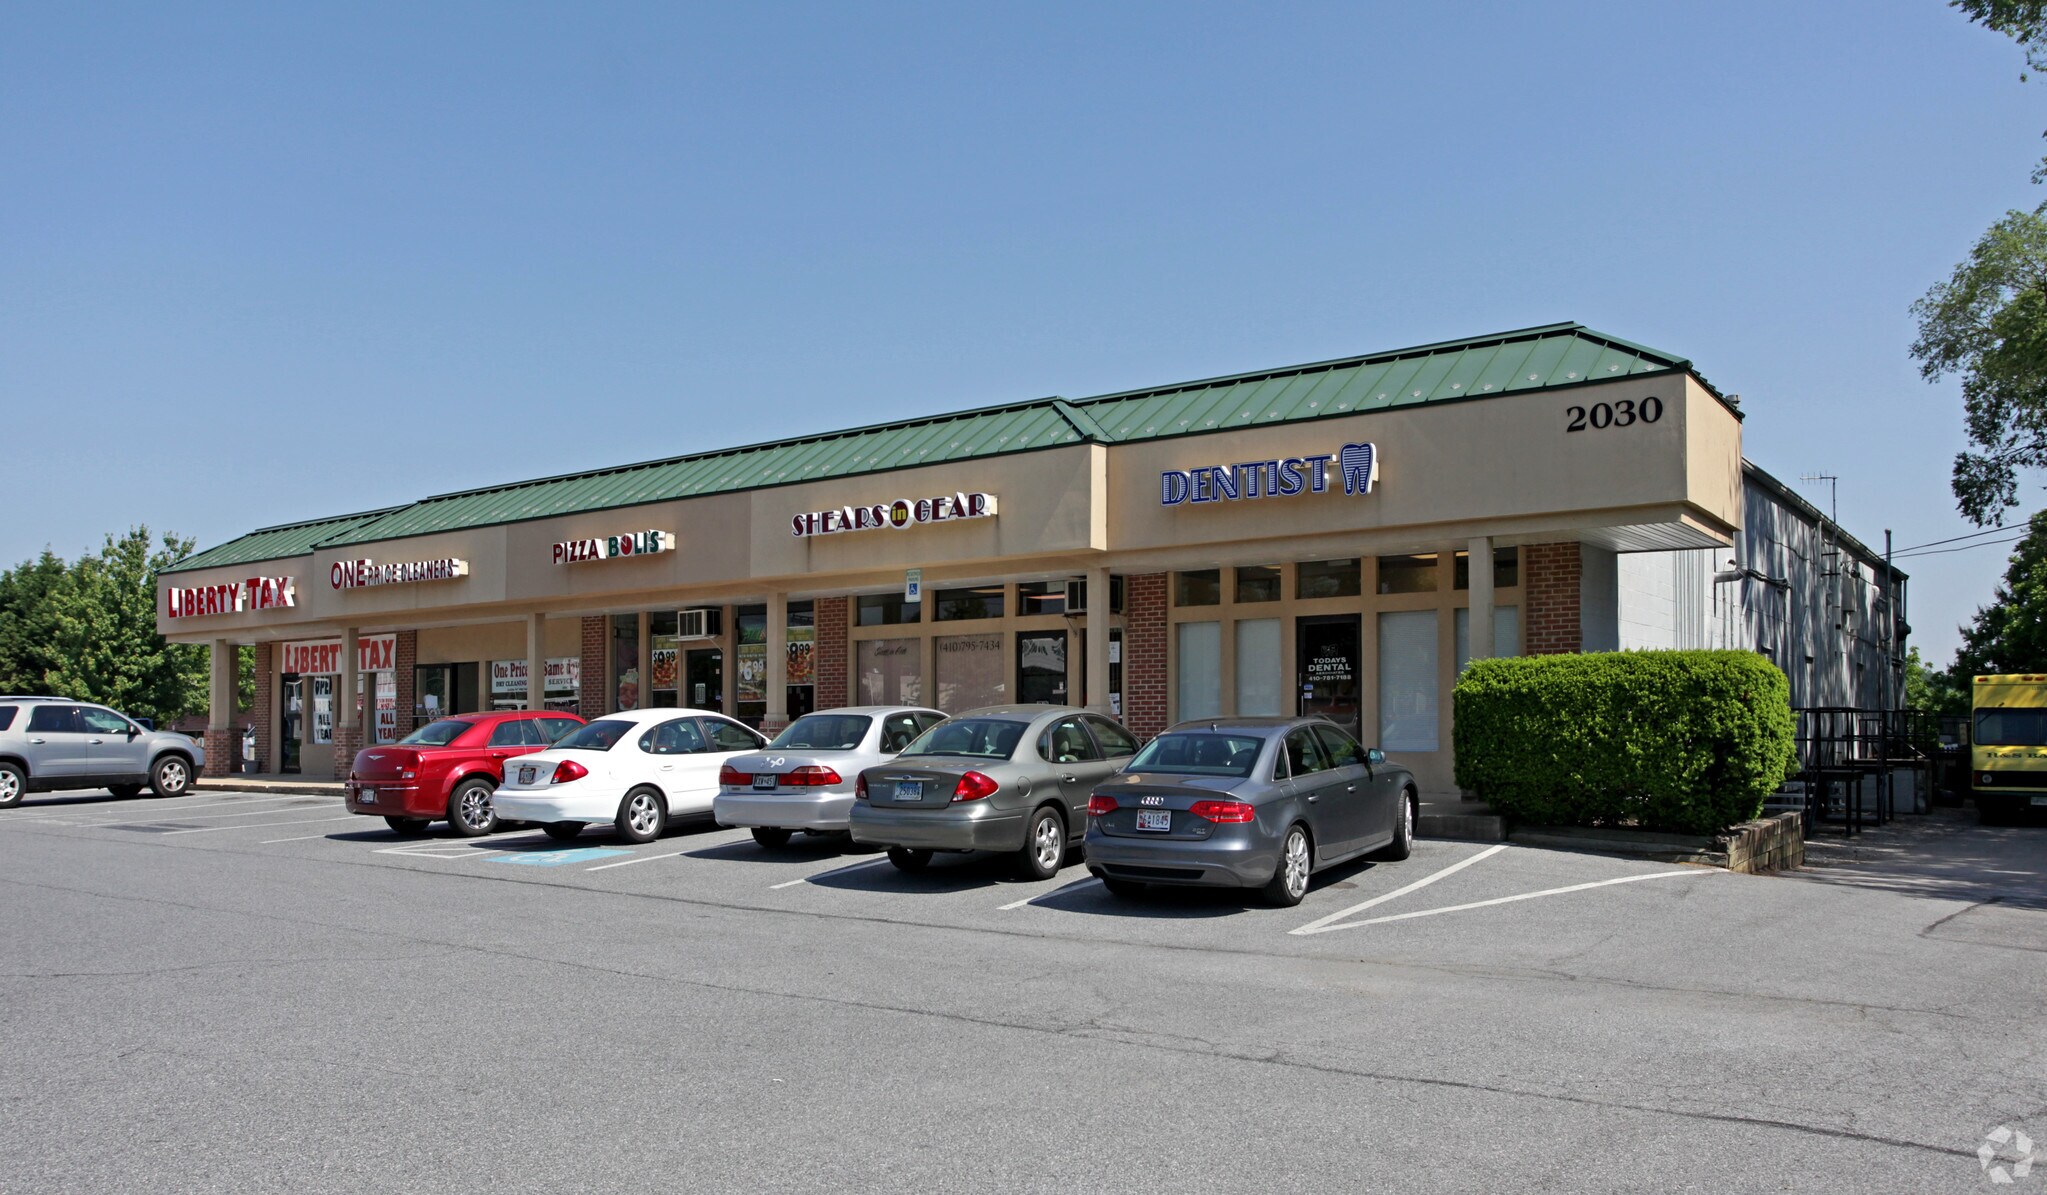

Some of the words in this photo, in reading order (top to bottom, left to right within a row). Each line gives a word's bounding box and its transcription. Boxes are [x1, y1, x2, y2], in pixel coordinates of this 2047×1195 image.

[1566, 396, 1663, 433] 2030
[1160, 454, 1333, 506] DENTIST
[792, 506, 887, 537] SHEARS
[891, 506, 907, 522] in
[914, 493, 987, 523] GEAR
[553, 539, 602, 564] PIZZA
[608, 529, 662, 557] BOLI'S
[331, 559, 367, 590] ONE
[367, 564, 399, 585] PRICE
[400, 559, 456, 583] CLEANERS
[168, 583, 241, 618] LIBERTY
[246, 577, 292, 610] TAX
[285, 643, 343, 674] LIBERT
[358, 638, 394, 671] TAX
[494, 663, 509, 678] One
[544, 661, 564, 676] Same
[318, 714, 331, 725] ALL
[380, 713, 394, 725] ALL
